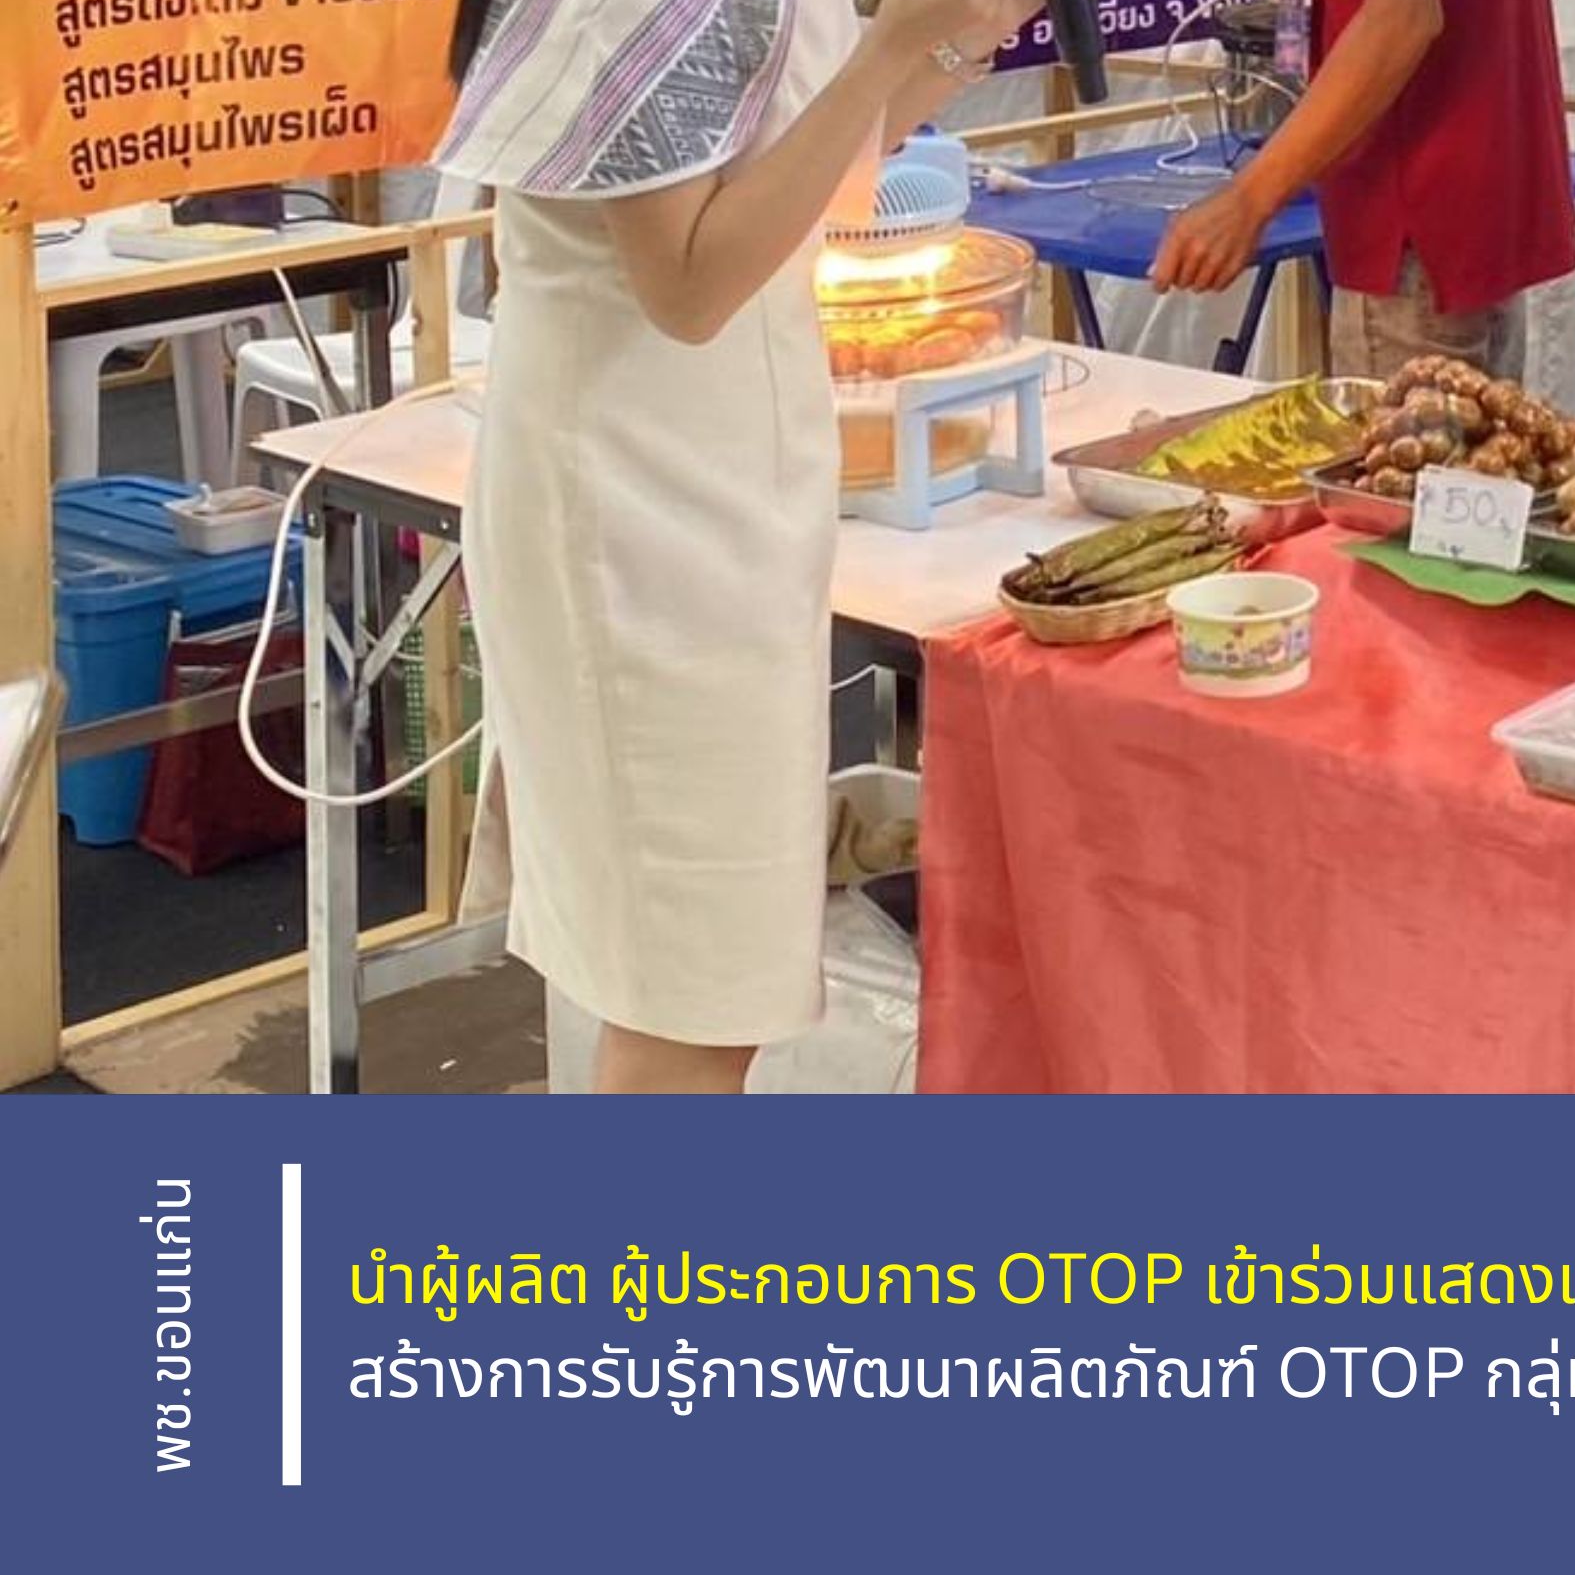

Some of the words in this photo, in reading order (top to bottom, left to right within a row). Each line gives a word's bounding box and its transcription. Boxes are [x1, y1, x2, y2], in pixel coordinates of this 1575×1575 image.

[63, 37, 305, 120] สูตรสมุนไพร
[69, 85, 378, 191] สูตรสมุนไพรเผ็ด
